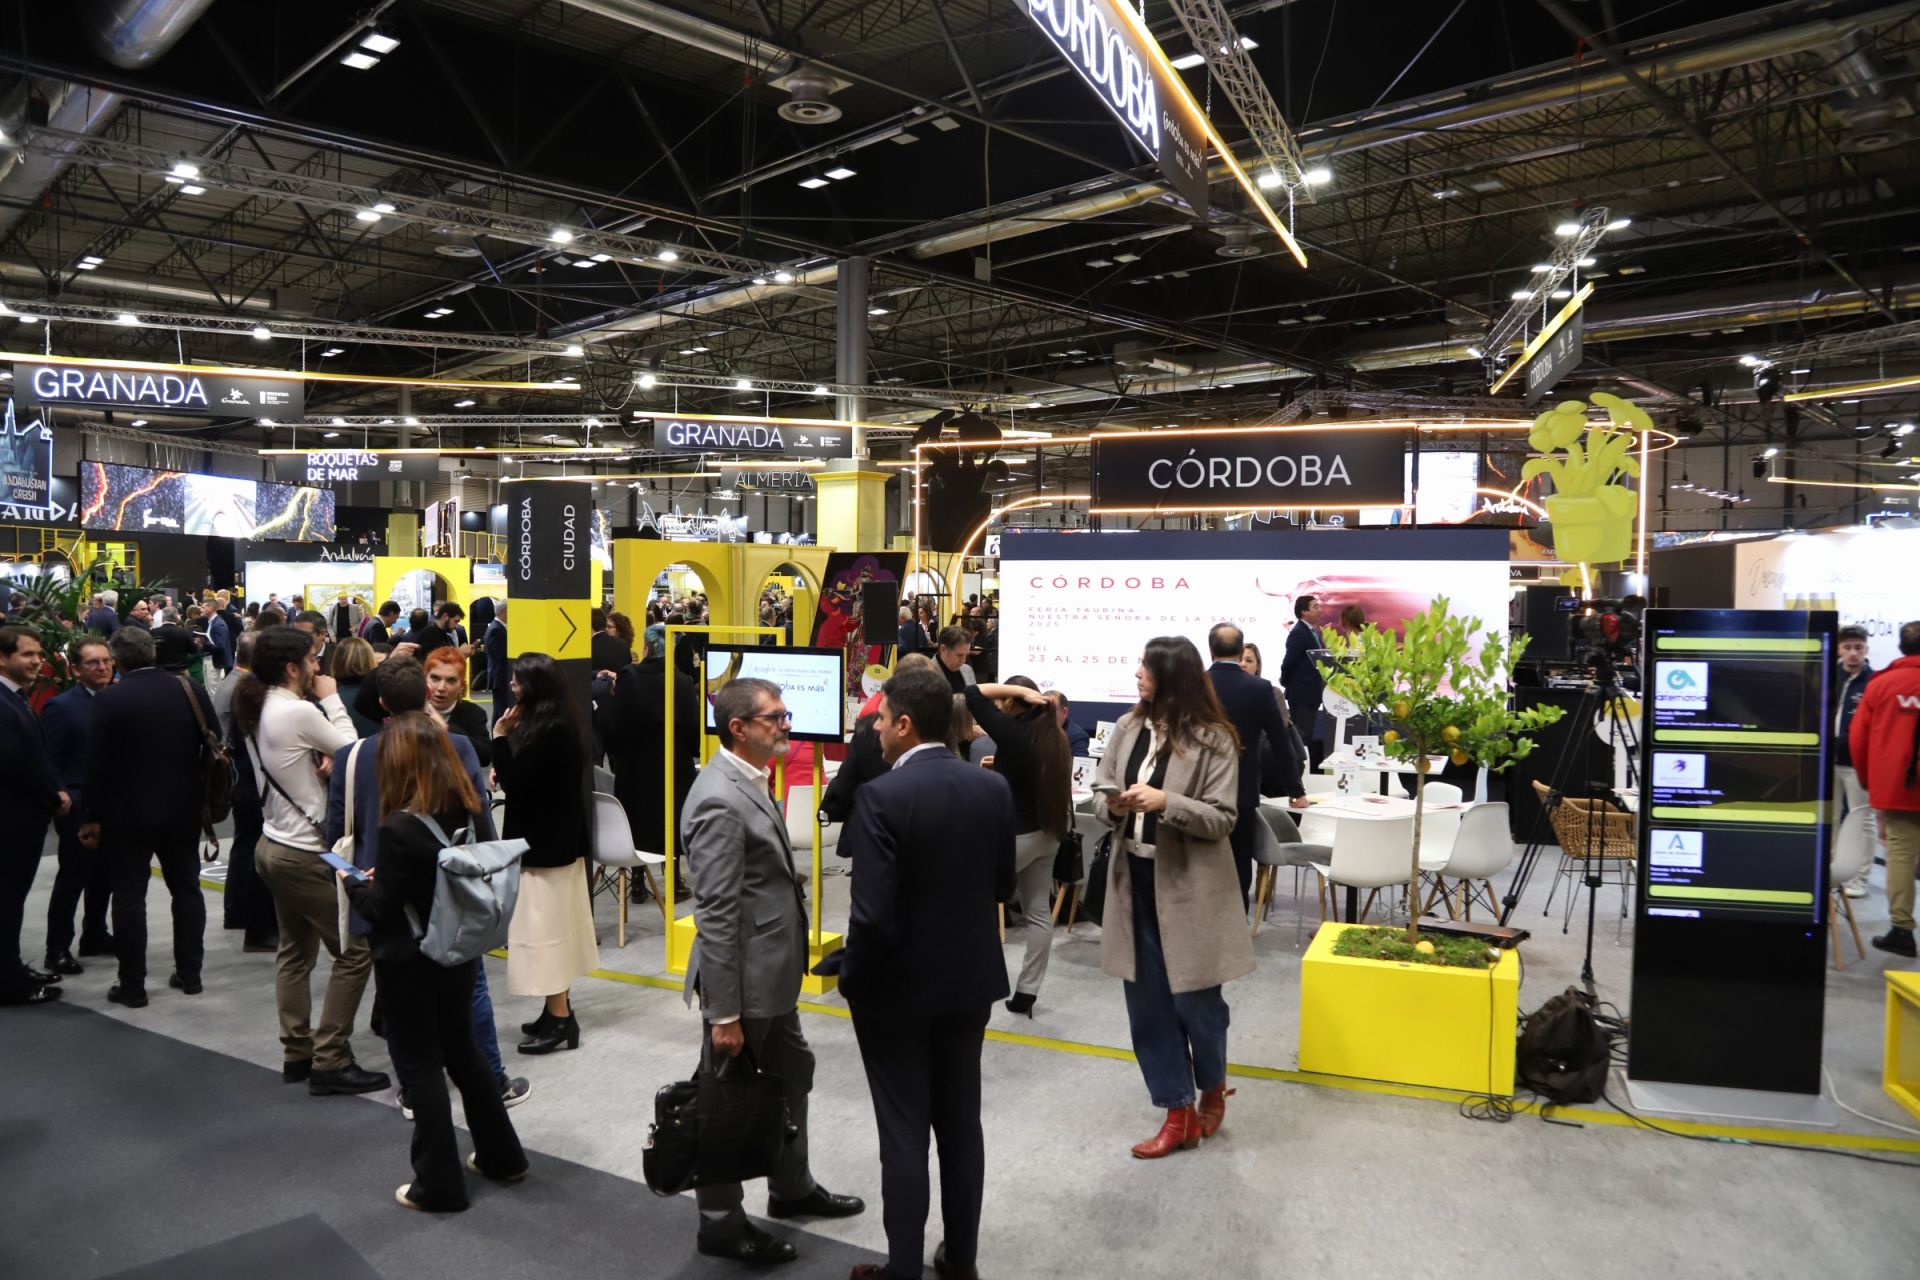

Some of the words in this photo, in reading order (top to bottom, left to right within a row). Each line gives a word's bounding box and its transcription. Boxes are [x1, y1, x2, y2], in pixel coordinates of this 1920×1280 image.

[1529, 351, 1553, 389] CÓRDOBA
[33, 367, 209, 405] GRANADA
[667, 422, 784, 449] GRANADA
[307, 453, 379, 468] ROQUETAS
[1148, 448, 1352, 489] CÓRDOBA
[307, 468, 325, 481] DE
[328, 468, 358, 481] MAR
[519, 497, 531, 581] CÓRDOBA
[563, 504, 576, 571] CIUDAD
[320, 545, 376, 562] Andalucía
[1030, 573, 1190, 589] CÓRDOBA
[1028, 654, 1046, 663] 23
[1054, 655, 1073, 664] AL
[1082, 655, 1100, 664] 25
[1108, 656, 1128, 665] DE
